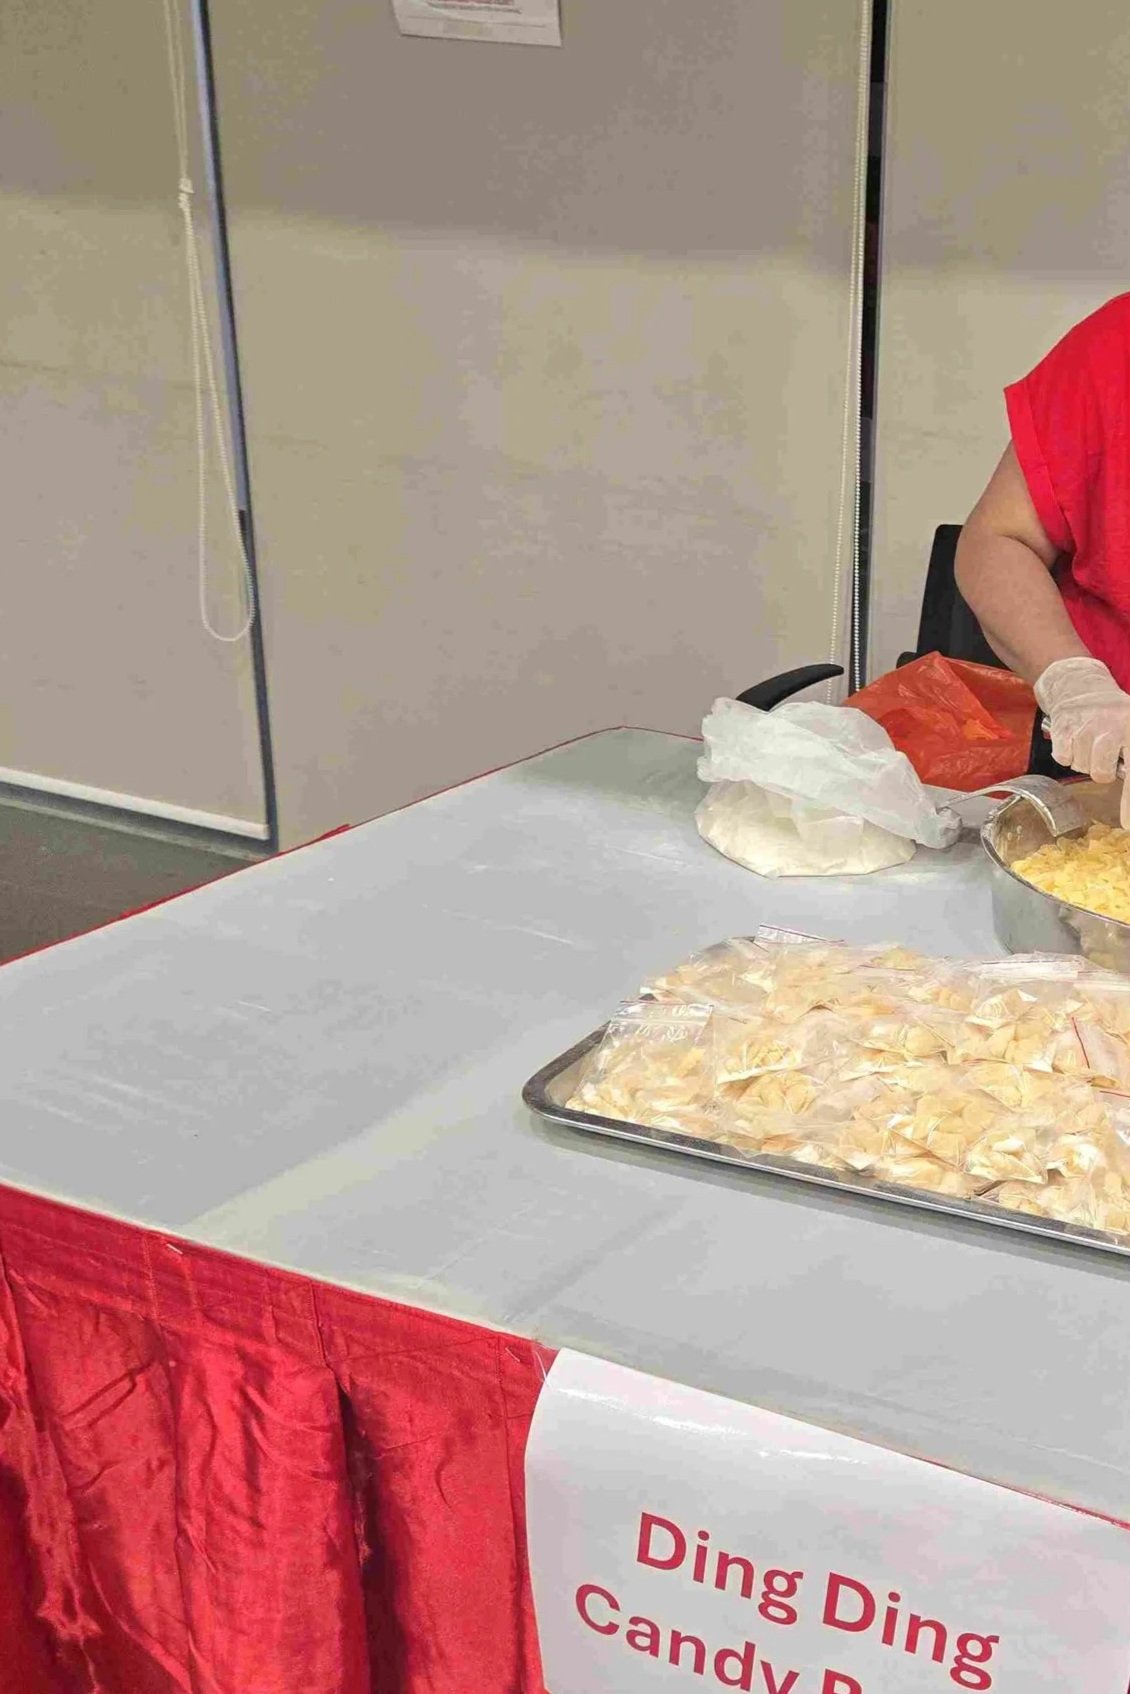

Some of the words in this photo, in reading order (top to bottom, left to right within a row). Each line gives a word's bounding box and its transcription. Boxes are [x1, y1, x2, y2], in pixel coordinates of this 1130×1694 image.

[574, 1582, 799, 1694] Candy
[636, 1512, 803, 1626] Ding
[823, 1571, 999, 1691] Ding
